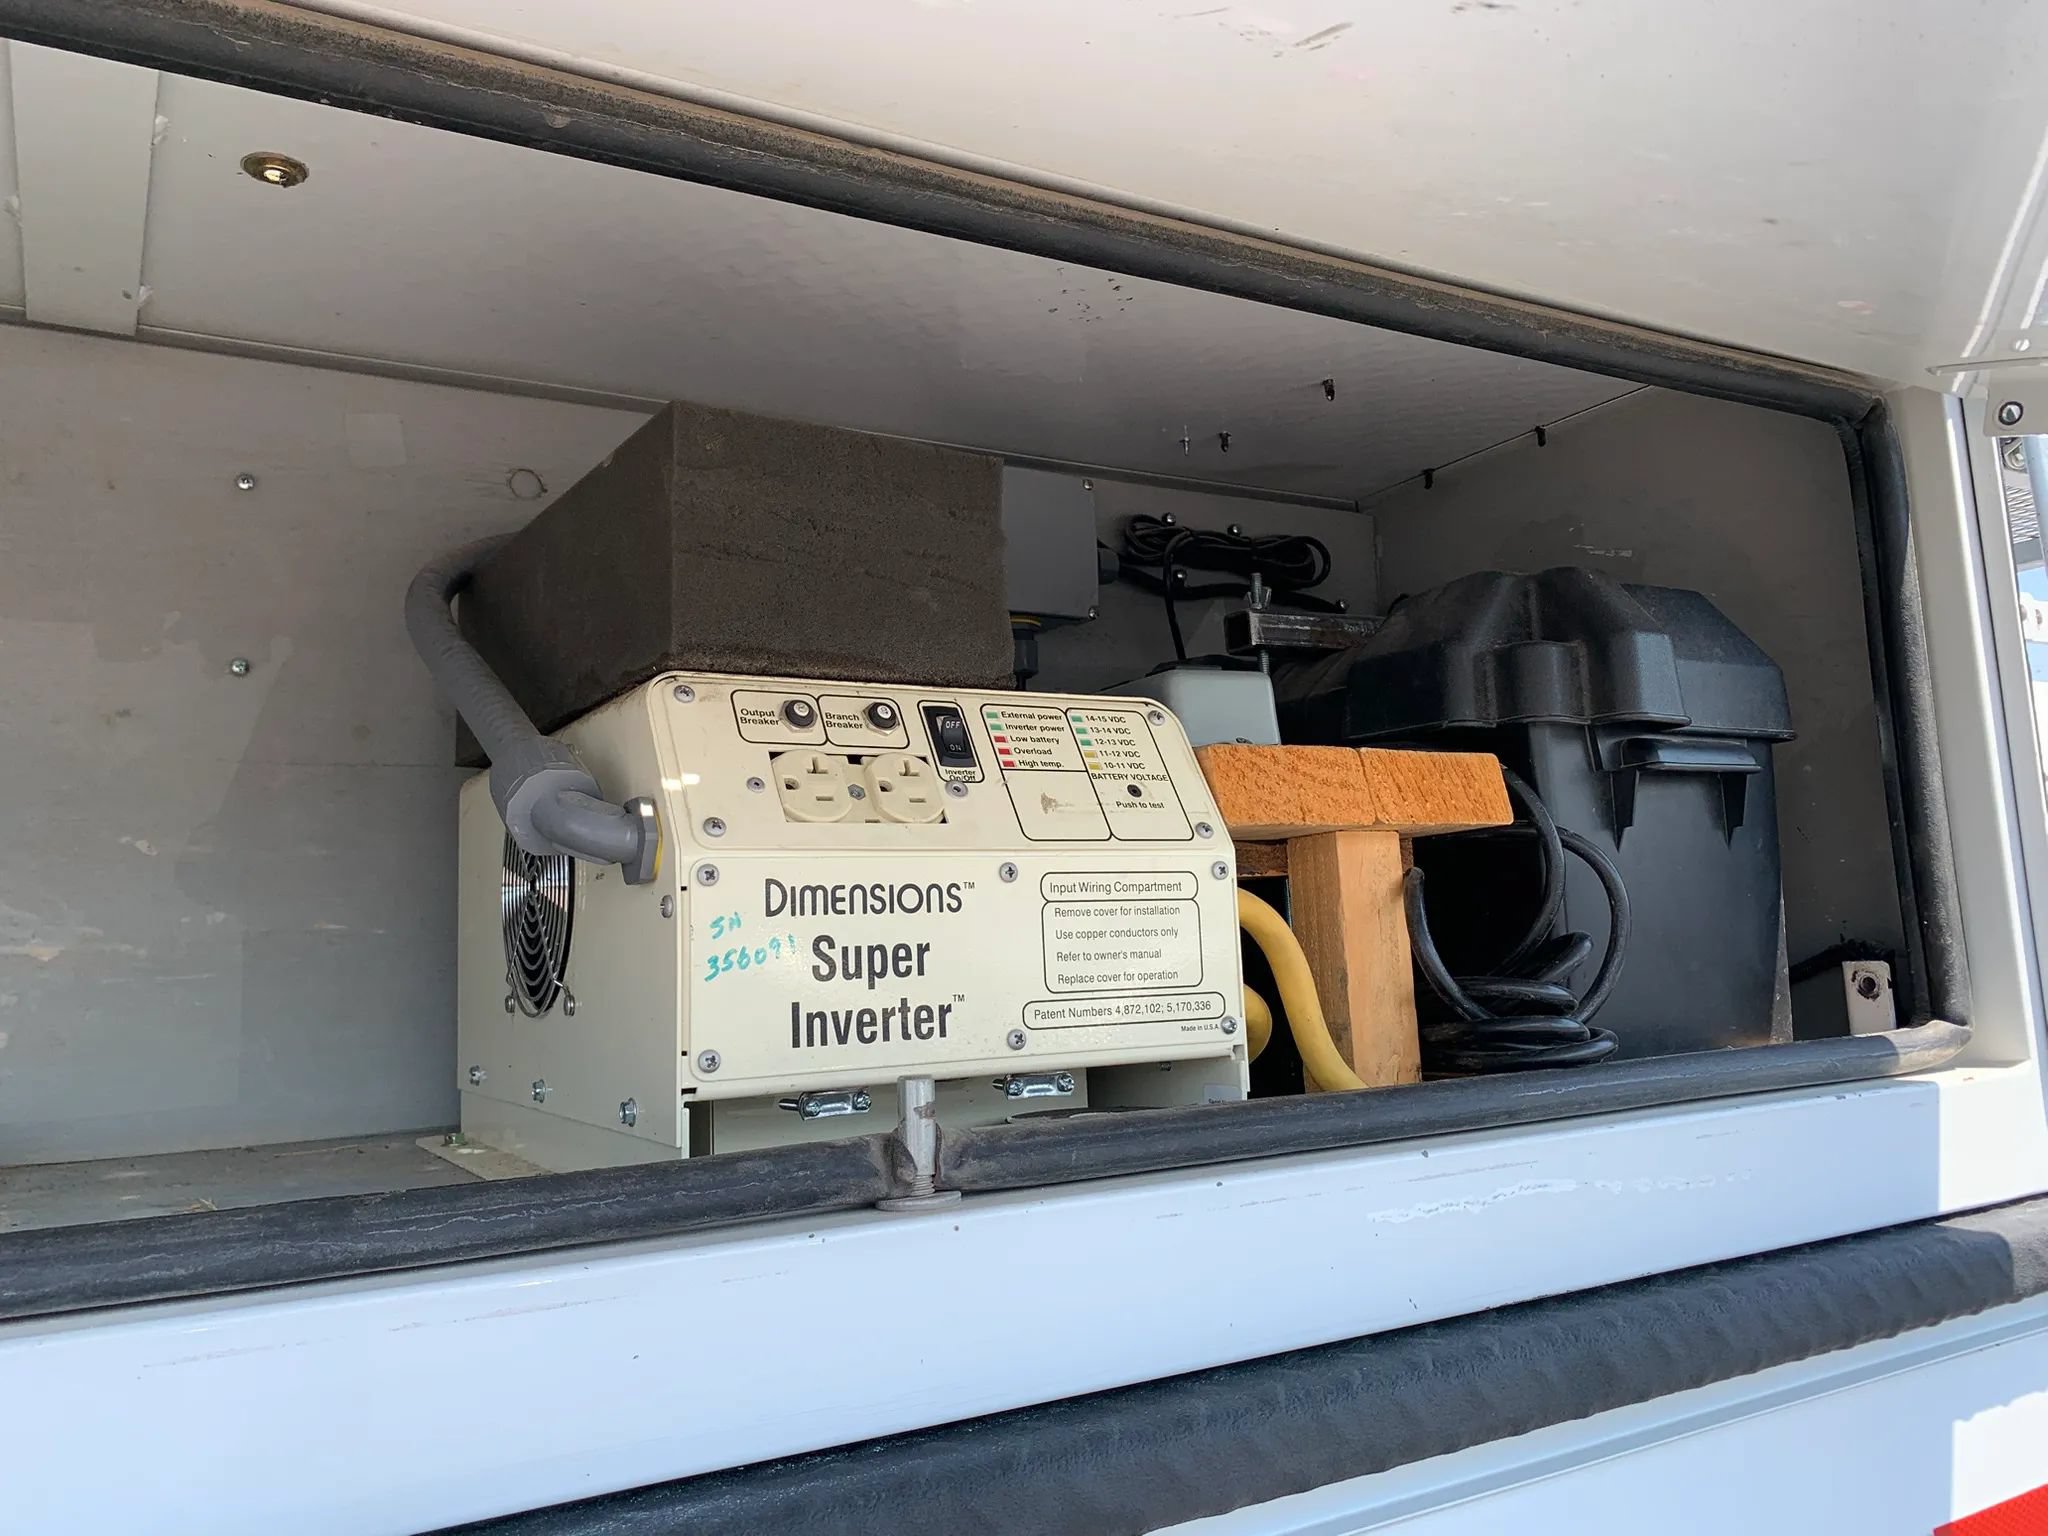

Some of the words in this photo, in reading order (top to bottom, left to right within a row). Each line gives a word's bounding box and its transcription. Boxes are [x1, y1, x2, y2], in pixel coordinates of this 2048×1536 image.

[740, 708, 775, 718] Output
[825, 712, 859, 721] Branch
[1001, 711, 1036, 719] External
[740, 717, 779, 725] Breaker
[825, 720, 863, 729] Breaker
[945, 720, 961, 729] OFF
[1005, 723, 1037, 731] Inverter
[1090, 727, 1112, 735] 13-14
[1010, 735, 1028, 743] Low
[1029, 736, 1060, 745] battery
[1095, 738, 1117, 746] 12-13
[1117, 739, 1136, 747] VDC
[949, 743, 961, 752] ON
[1013, 747, 1053, 755] Overload
[1099, 750, 1121, 758] 11-12
[1018, 759, 1039, 769] High
[1039, 760, 1065, 769] temp.
[1127, 762, 1146, 770] VDC
[1090, 772, 1129, 781] BATTERY
[1130, 773, 1169, 782] VOLTAGE
[1115, 800, 1138, 808] Push
[1138, 801, 1148, 809] to
[1148, 801, 1165, 809] test
[1049, 882, 1077, 895] Input
[1078, 881, 1112, 895] Wiring
[1113, 880, 1183, 895] Compartment
[1054, 907, 1092, 917] Remove
[1093, 908, 1119, 917] cover
[1120, 905, 1132, 916] for
[1133, 905, 1181, 916] installation
[1055, 929, 1074, 940] Use
[1075, 930, 1108, 941] copper
[1109, 927, 1159, 938] conductors
[1160, 926, 1179, 939] only
[1056, 951, 1081, 962] Refer
[1082, 951, 1092, 961] to
[1093, 950, 1128, 960] owner's
[1129, 948, 1162, 959] manual
[812, 934, 930, 990] Super
[1057, 973, 1095, 986] Replace
[1096, 973, 1122, 982] cover
[1123, 971, 1135, 981] for
[1137, 970, 1179, 982] operation
[1034, 1008, 1066, 1020] Patent
[1068, 1006, 1112, 1018] Numbers
[1115, 1003, 1164, 1016] 4,872,102;
[1166, 1000, 1212, 1013] 5,170,336
